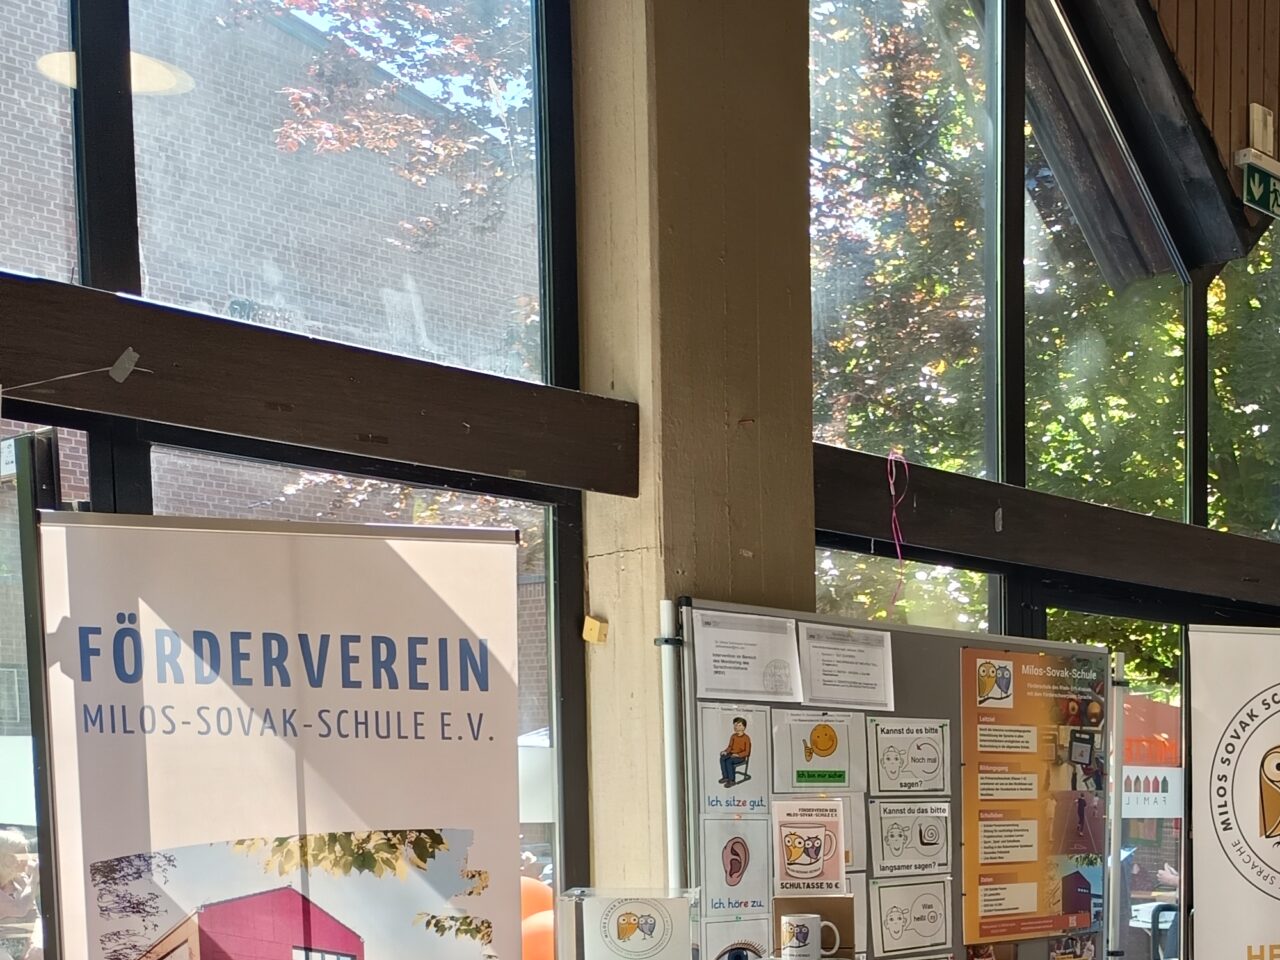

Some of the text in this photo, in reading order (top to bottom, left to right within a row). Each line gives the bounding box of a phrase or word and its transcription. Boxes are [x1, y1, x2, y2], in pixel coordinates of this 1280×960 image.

[78, 612, 490, 692] FÖRDERVEREIN
[1022, 664, 1097, 680] Milos-Sovak-Schule
[83, 702, 495, 742] MILOS-SOVAK-SCHULE E.V.
[880, 727, 904, 735] Kannst
[905, 727, 914, 735] du
[1221, 708, 1259, 767] SOVAK
[911, 756, 926, 764] Noch
[900, 780, 923, 789] sagen?
[707, 796, 722, 807] Ich
[725, 796, 747, 807] sitze
[1216, 774, 1233, 832] MILOS
[882, 807, 906, 815] Kannst
[930, 806, 946, 814] bitte
[880, 861, 937, 873] langsamer sagen?
[1230, 839, 1276, 885] SPRACHE
[780, 881, 825, 889] SCHULTASSE
[834, 881, 840, 889] €
[711, 898, 726, 909] Ich
